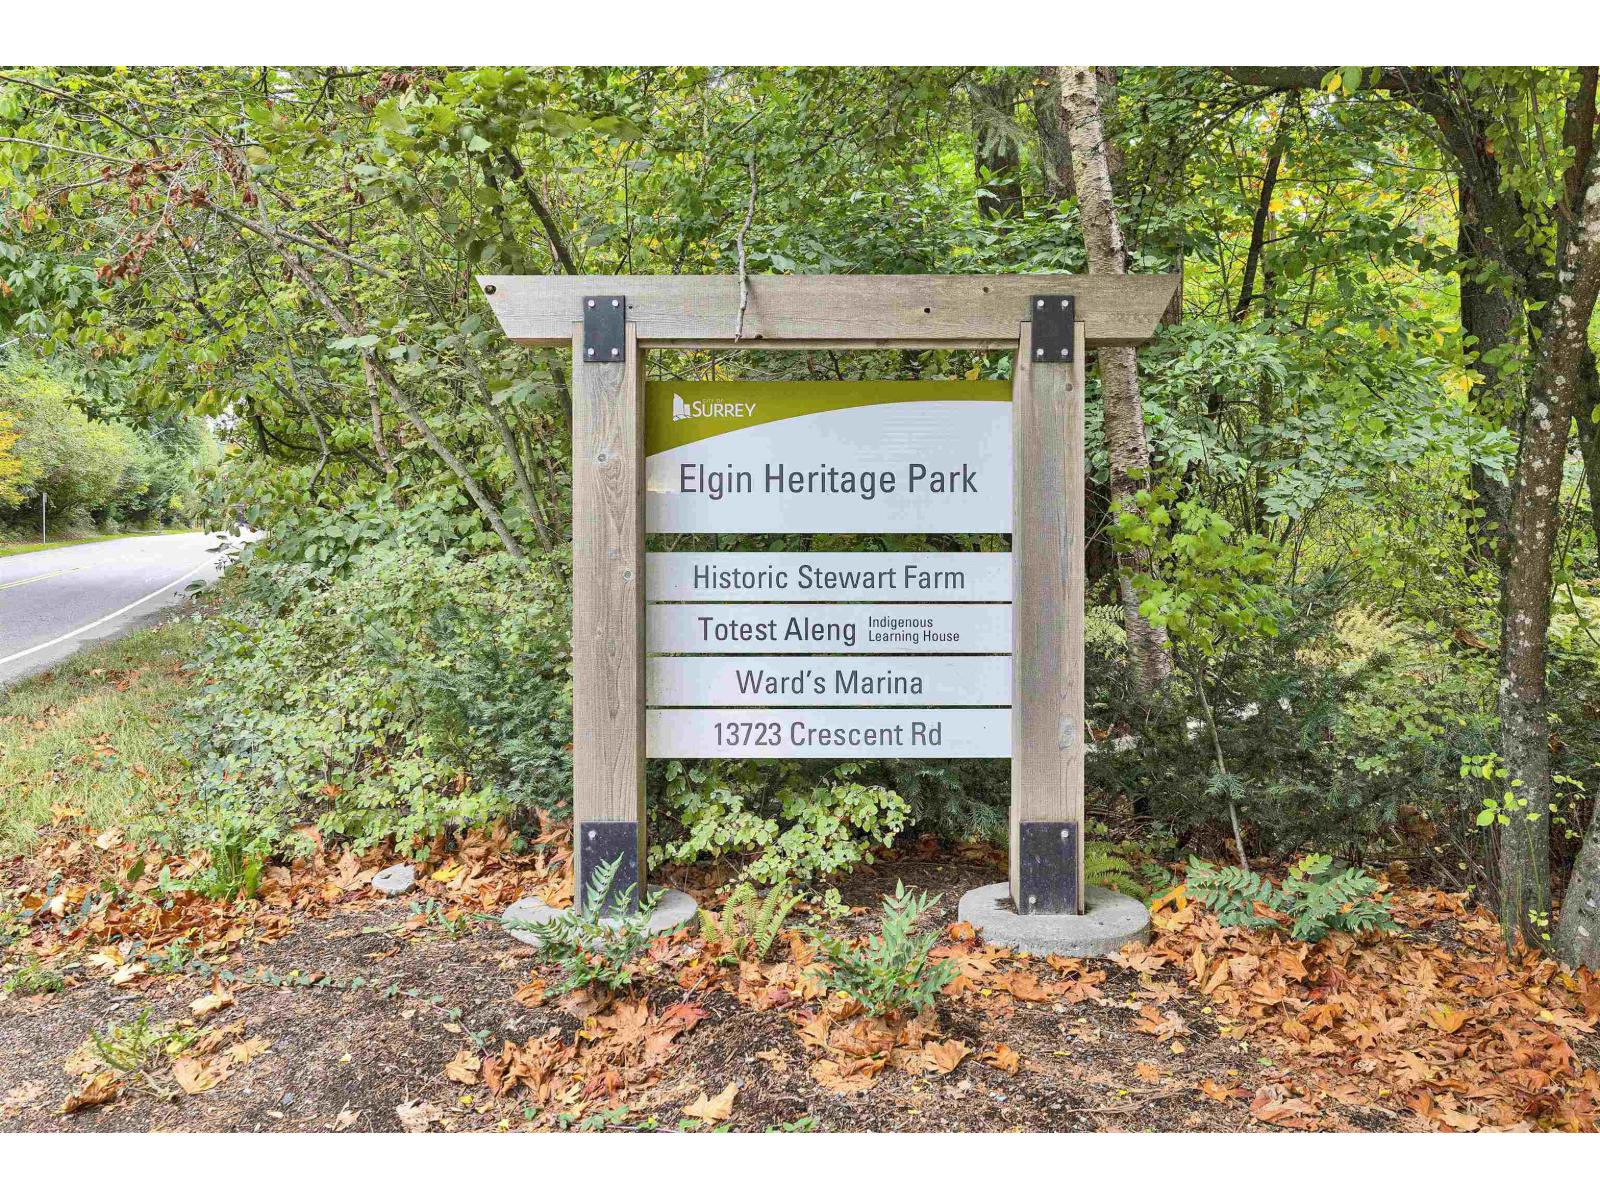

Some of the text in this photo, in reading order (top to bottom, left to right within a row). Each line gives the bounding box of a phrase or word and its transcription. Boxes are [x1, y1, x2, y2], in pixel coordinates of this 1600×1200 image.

[692, 400, 757, 418] SURREY
[680, 463, 978, 501] Elgin Heritage Park
[693, 564, 965, 590] Historic Stewart Farm
[697, 616, 856, 647] Totest Aleng
[868, 615, 934, 631] Indigenous
[868, 629, 960, 645] Learning House
[735, 669, 923, 695] Ward's Marina
[713, 721, 942, 747] 13723 Crescent Rd
